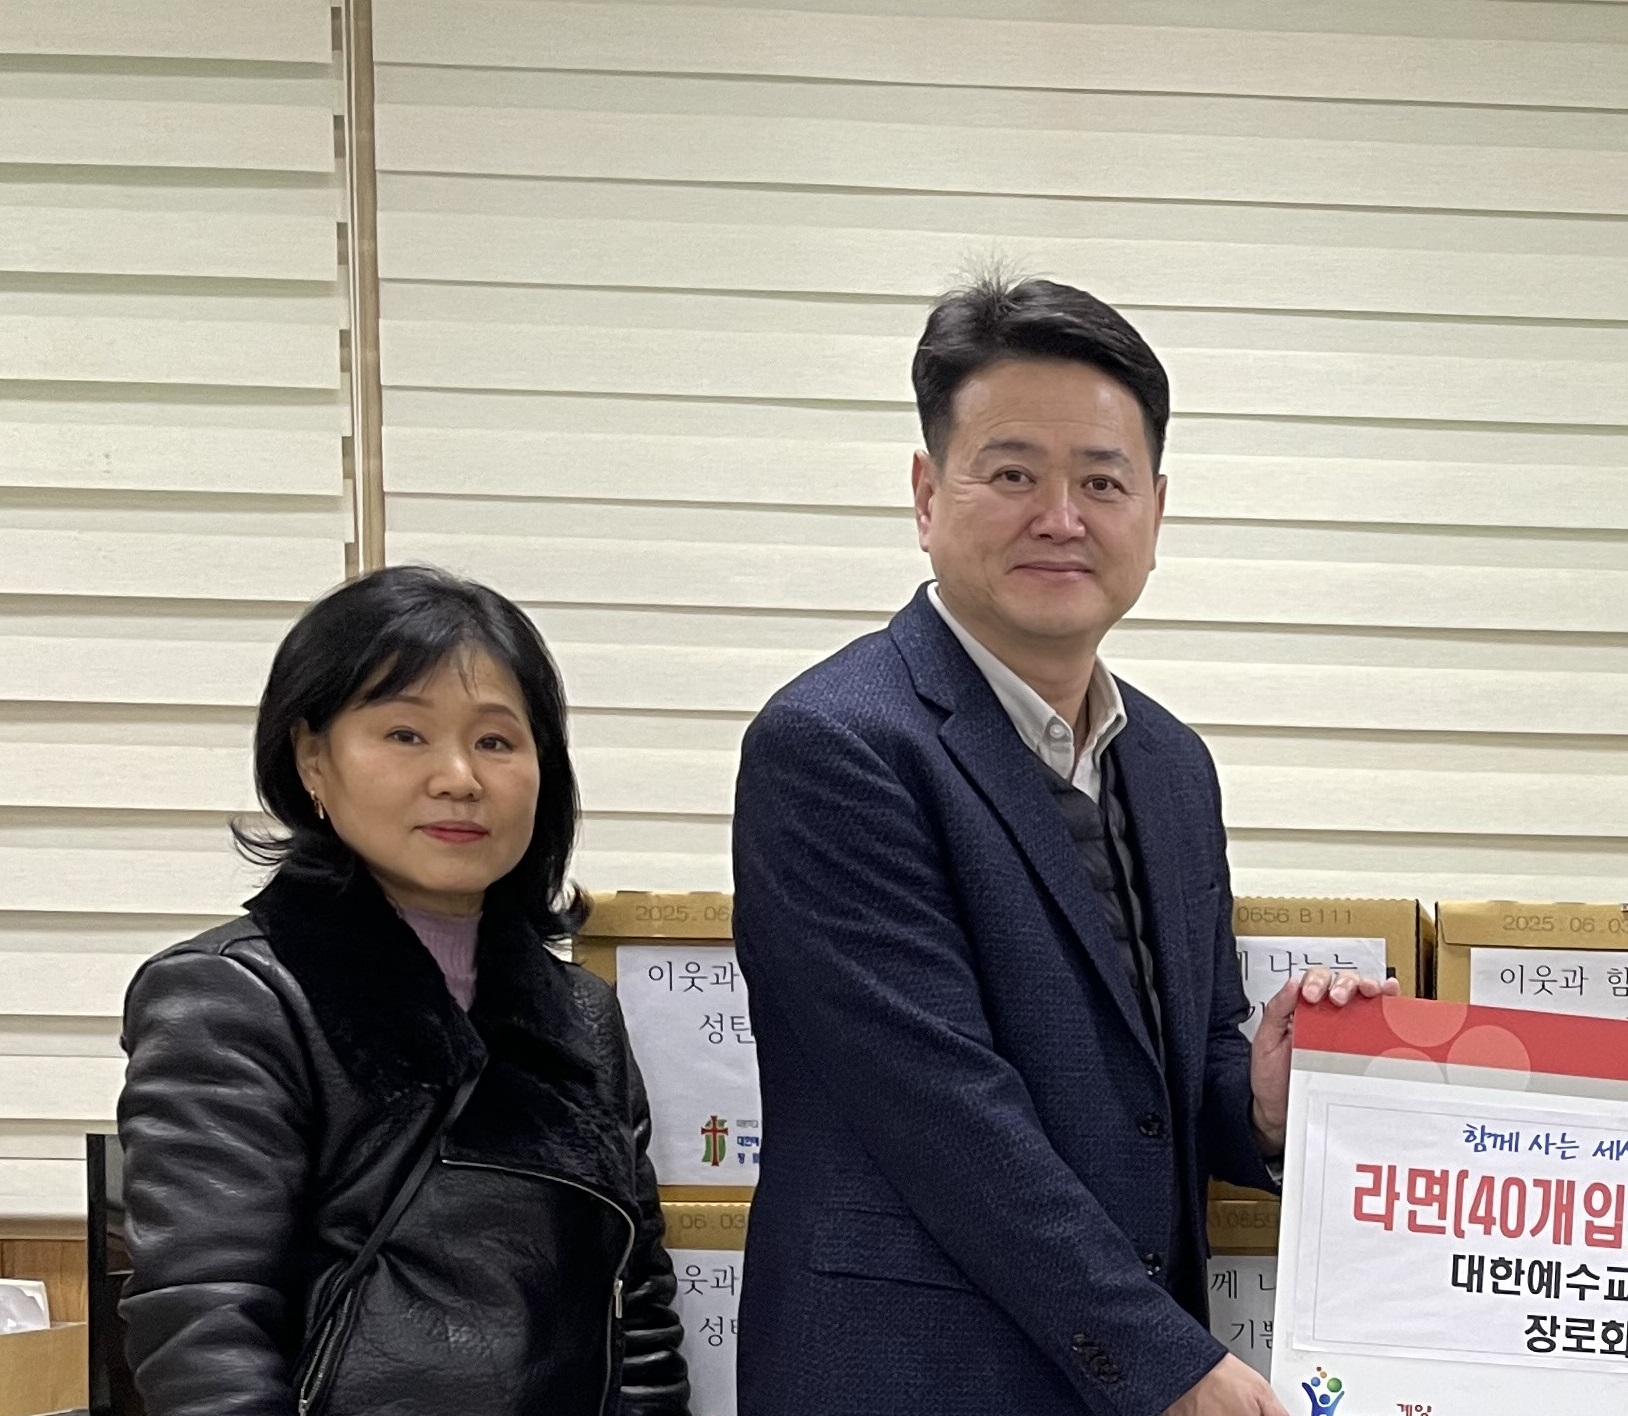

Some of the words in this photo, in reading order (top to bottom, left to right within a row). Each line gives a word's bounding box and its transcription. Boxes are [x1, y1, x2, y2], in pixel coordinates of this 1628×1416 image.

[648, 954, 746, 993] 이웃과
[1500, 964, 1590, 997] 이웃과
[1462, 1123, 1521, 1153] 함께
[1527, 1132, 1580, 1161] 사는
